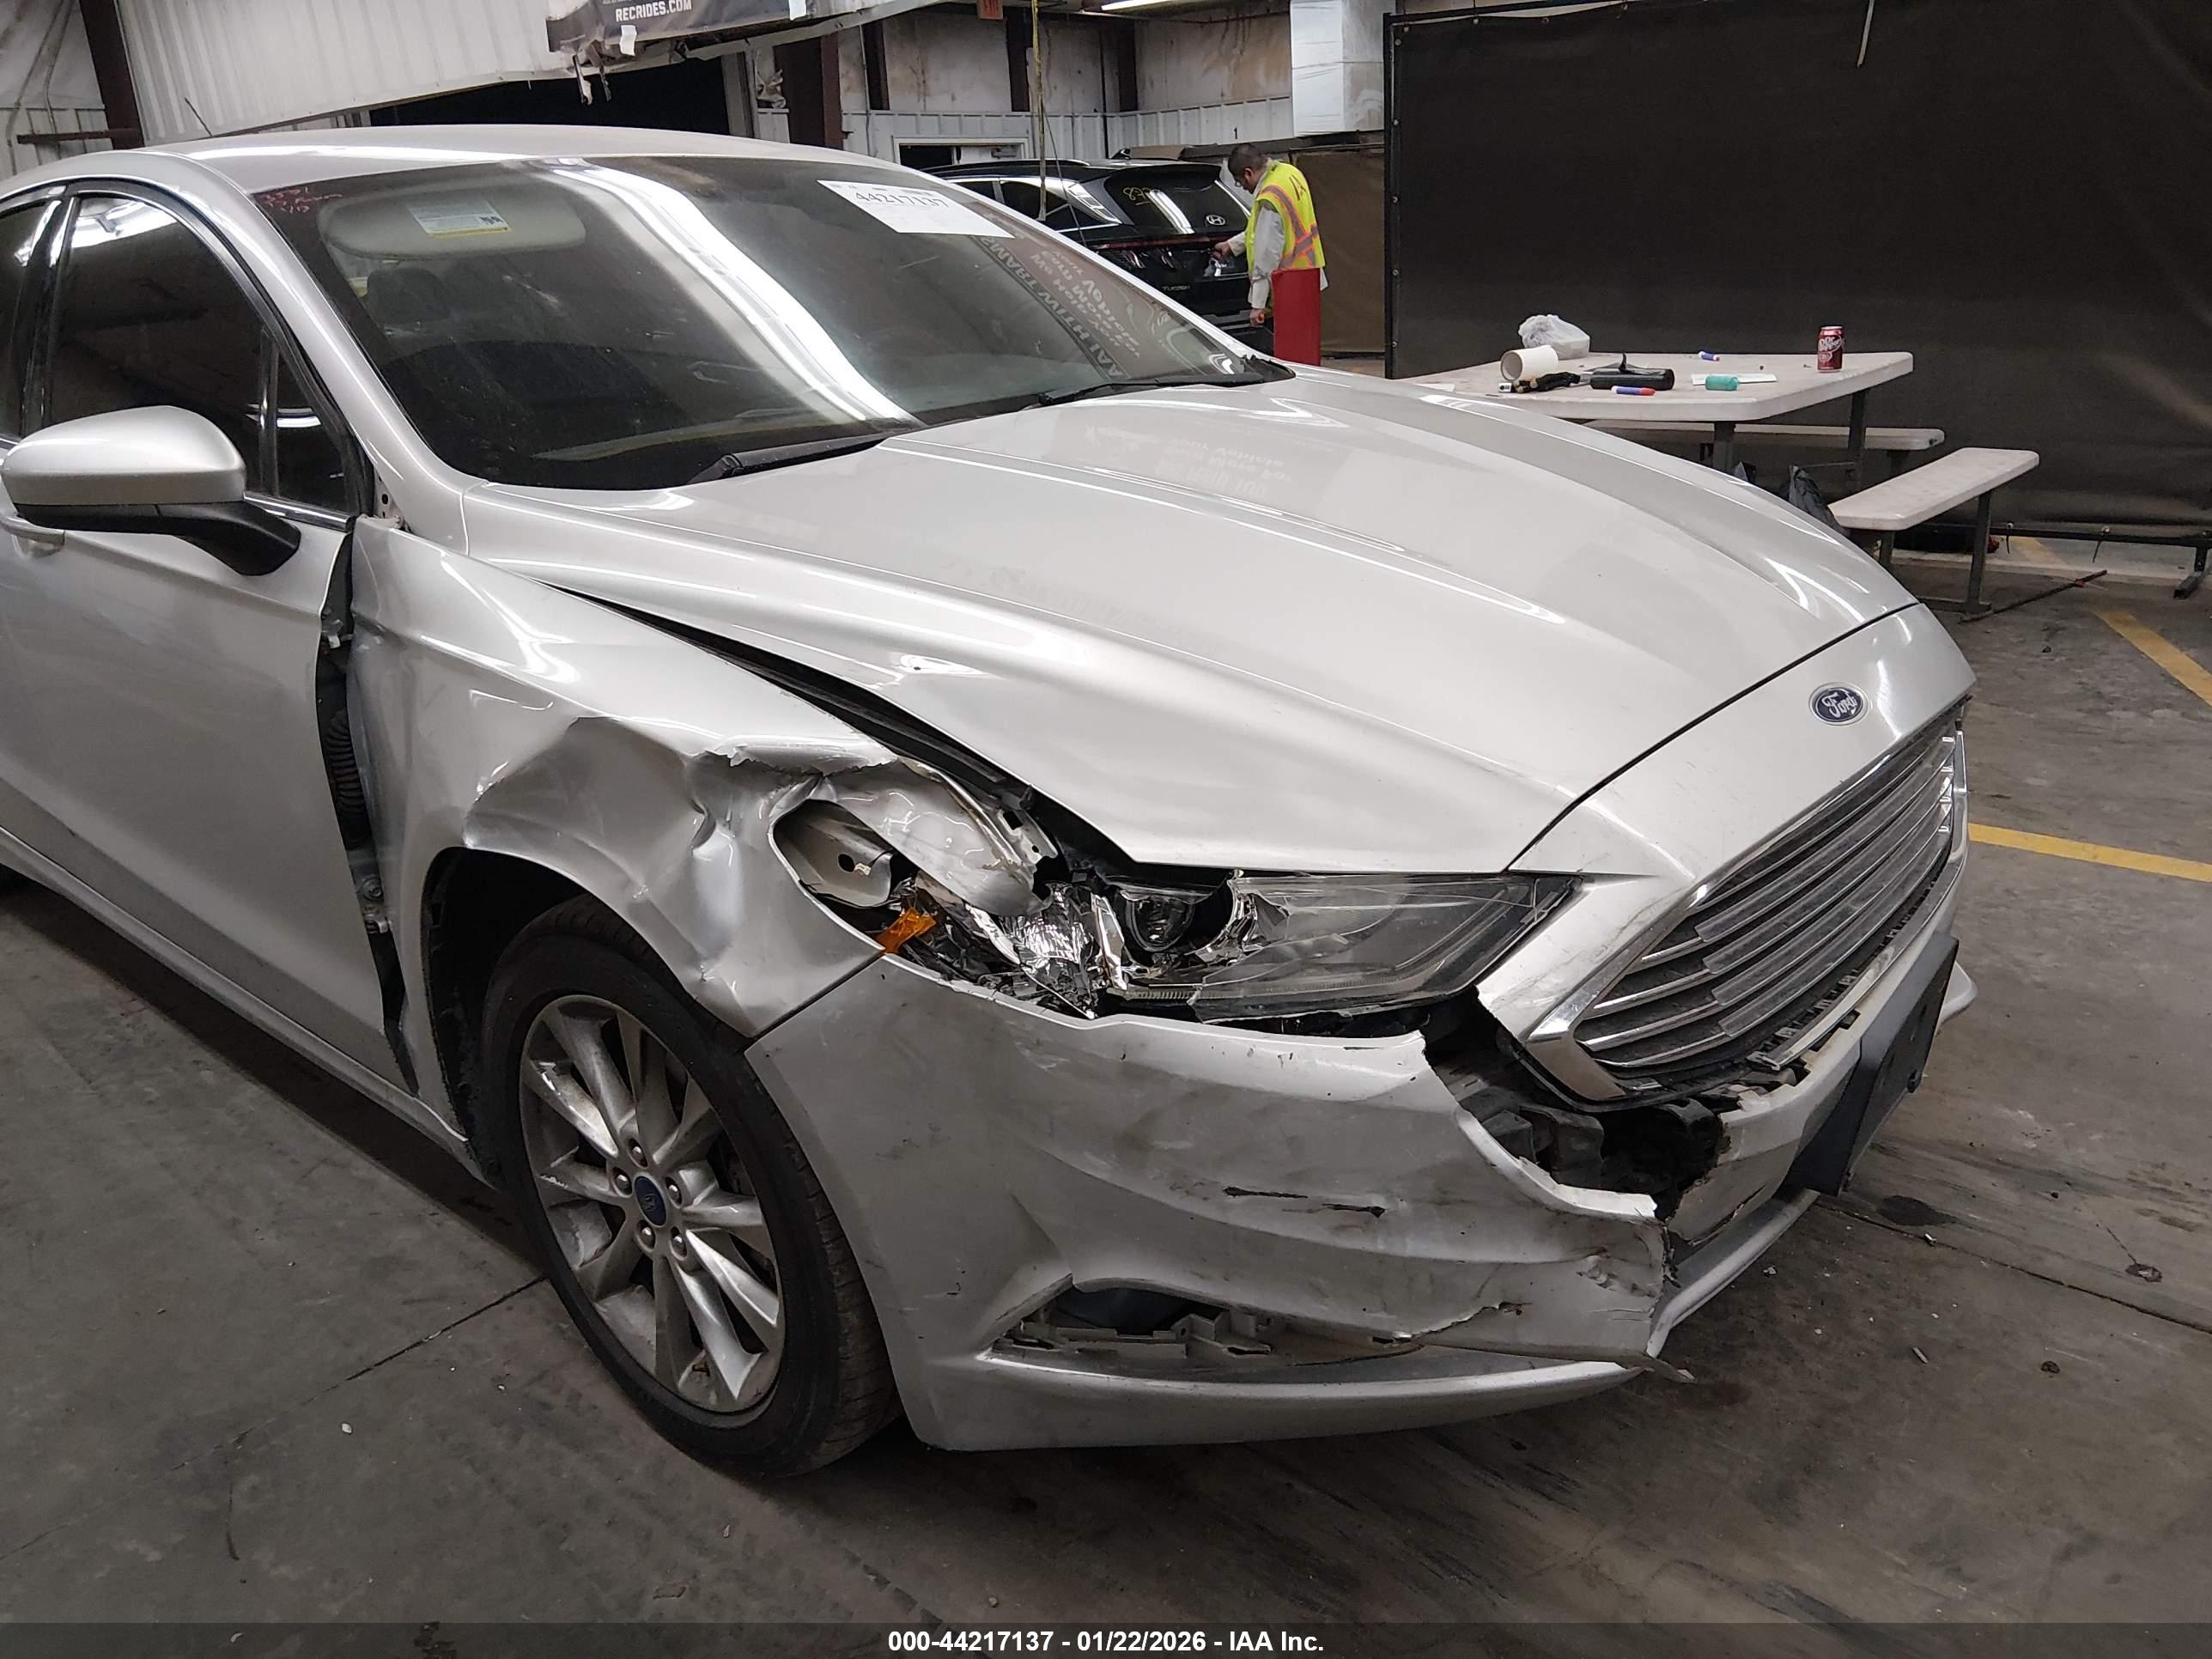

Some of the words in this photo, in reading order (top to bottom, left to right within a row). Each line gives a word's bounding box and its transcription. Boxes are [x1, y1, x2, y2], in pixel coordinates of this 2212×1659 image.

[616, 0, 692, 22] RECRIDES.COM
[855, 191, 949, 208] 44217137
[1821, 691, 1857, 717] Ford
